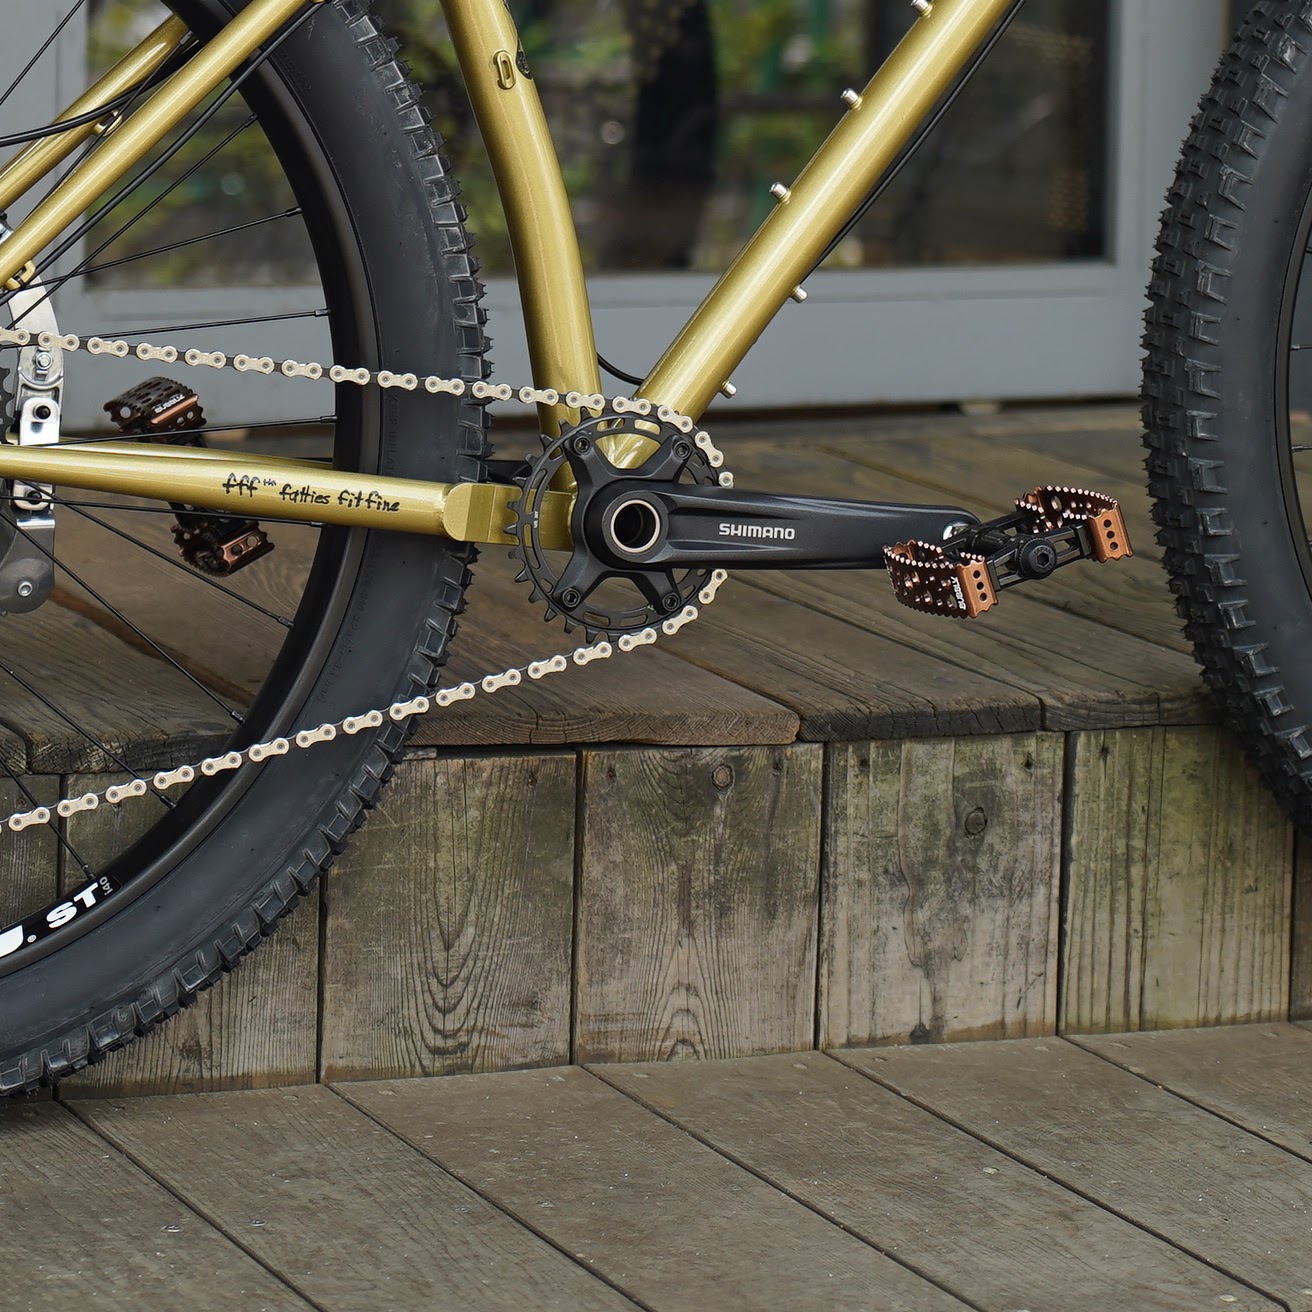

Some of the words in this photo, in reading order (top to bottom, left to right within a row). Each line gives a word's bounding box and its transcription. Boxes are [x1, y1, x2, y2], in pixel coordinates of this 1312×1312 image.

[279, 483, 331, 505] fatties
[338, 489, 364, 508] fit
[365, 490, 400, 512] fine
[719, 523, 795, 540] SHIMANO
[46, 882, 99, 929] ST
